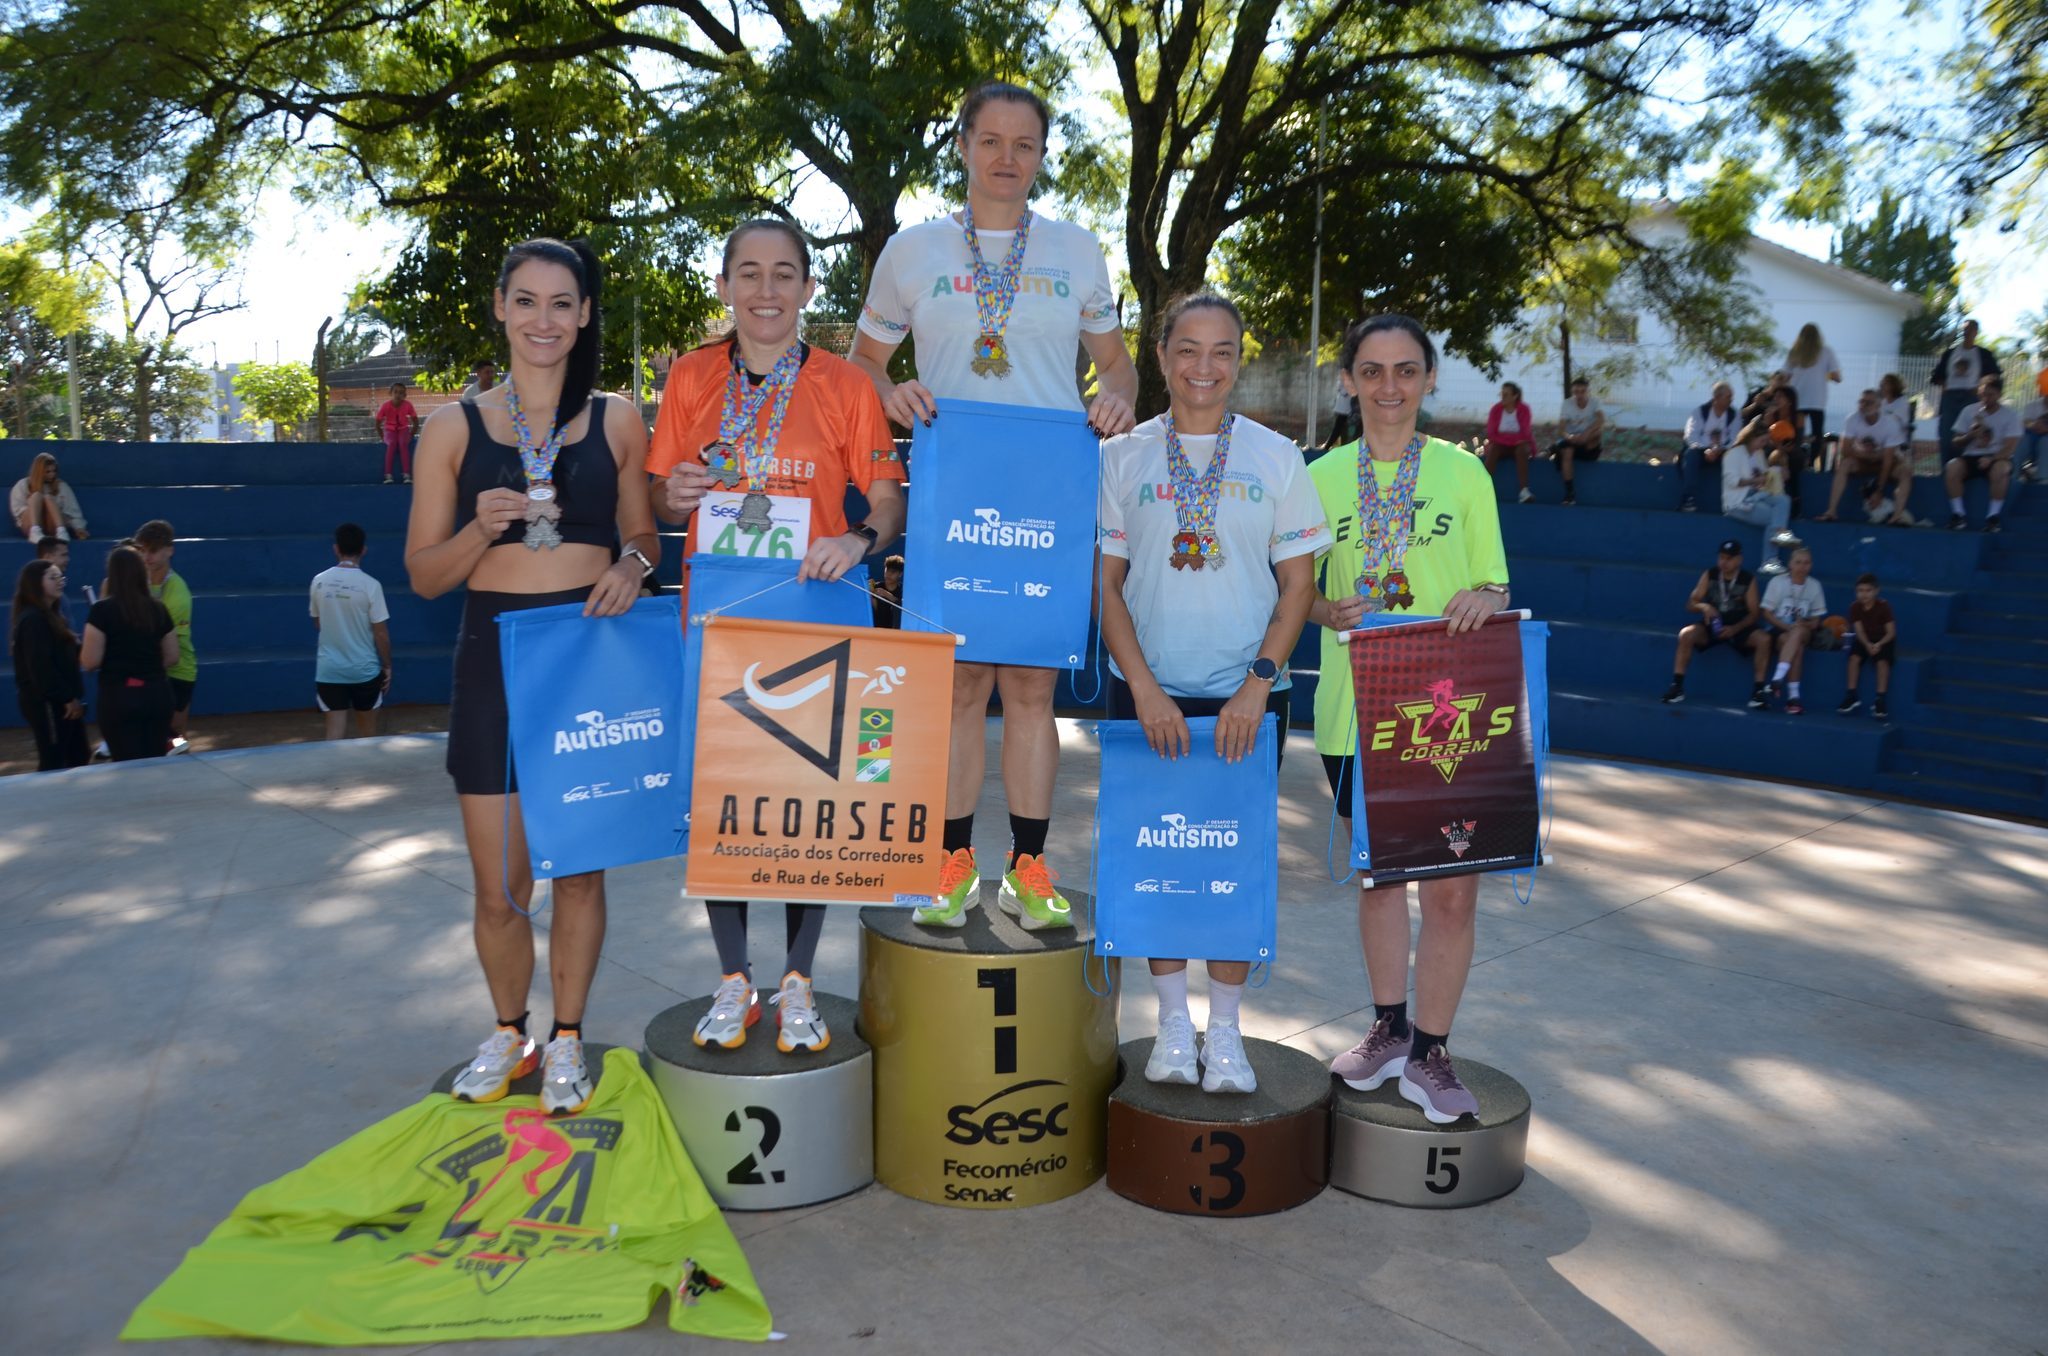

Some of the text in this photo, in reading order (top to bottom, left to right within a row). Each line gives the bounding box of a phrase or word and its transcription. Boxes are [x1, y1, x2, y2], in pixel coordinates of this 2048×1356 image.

[1138, 481, 1264, 507] Aumo
[711, 522, 794, 560] 476
[946, 519, 1055, 549] Autismo
[553, 719, 665, 755] Autismo
[1371, 705, 1516, 751] ELAS
[1400, 738, 1491, 762] CORREM
[718, 794, 928, 844] ACORSEB
[1135, 826, 1239, 848] Autismo
[713, 841, 924, 864] Associação dos Corredores
[751, 868, 884, 887] de Rua de Seberi
[977, 967, 1017, 1074] 1
[944, 1099, 1069, 1145] Sesc
[724, 1105, 785, 1185] 2
[943, 1154, 1068, 1179] Fecomércio
[1189, 1131, 1246, 1211] 3
[1425, 1146, 1462, 1194] 5
[944, 1184, 1014, 1203] Senac
